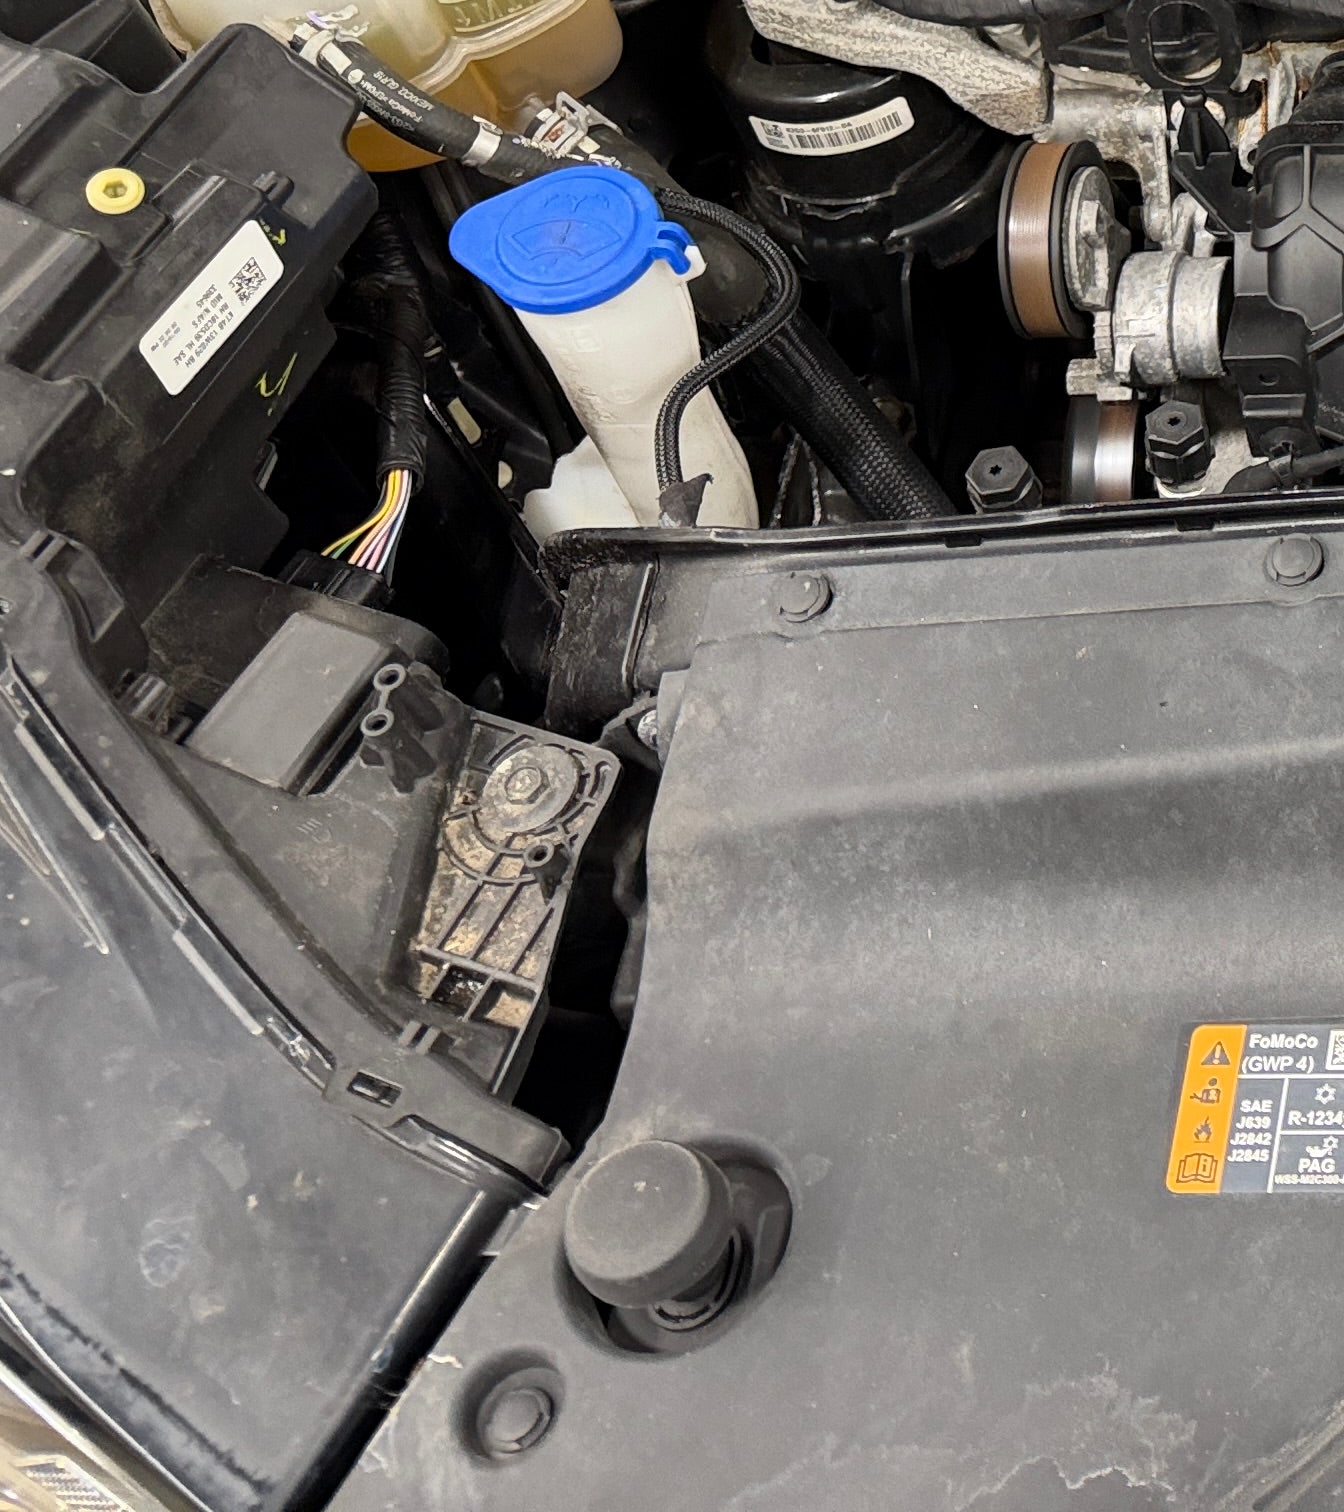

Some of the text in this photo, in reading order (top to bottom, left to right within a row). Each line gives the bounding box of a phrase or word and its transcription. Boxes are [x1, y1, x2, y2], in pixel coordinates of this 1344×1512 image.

[1249, 1033, 1319, 1049] FoMoCo
[1241, 1055, 1316, 1074] (GWP 4)
[1240, 1099, 1273, 1113] SAE
[1235, 1116, 1272, 1129] J639
[1230, 1132, 1273, 1146] J2842
[1227, 1149, 1270, 1163] J2845
[1297, 1157, 1336, 1174] PAG
